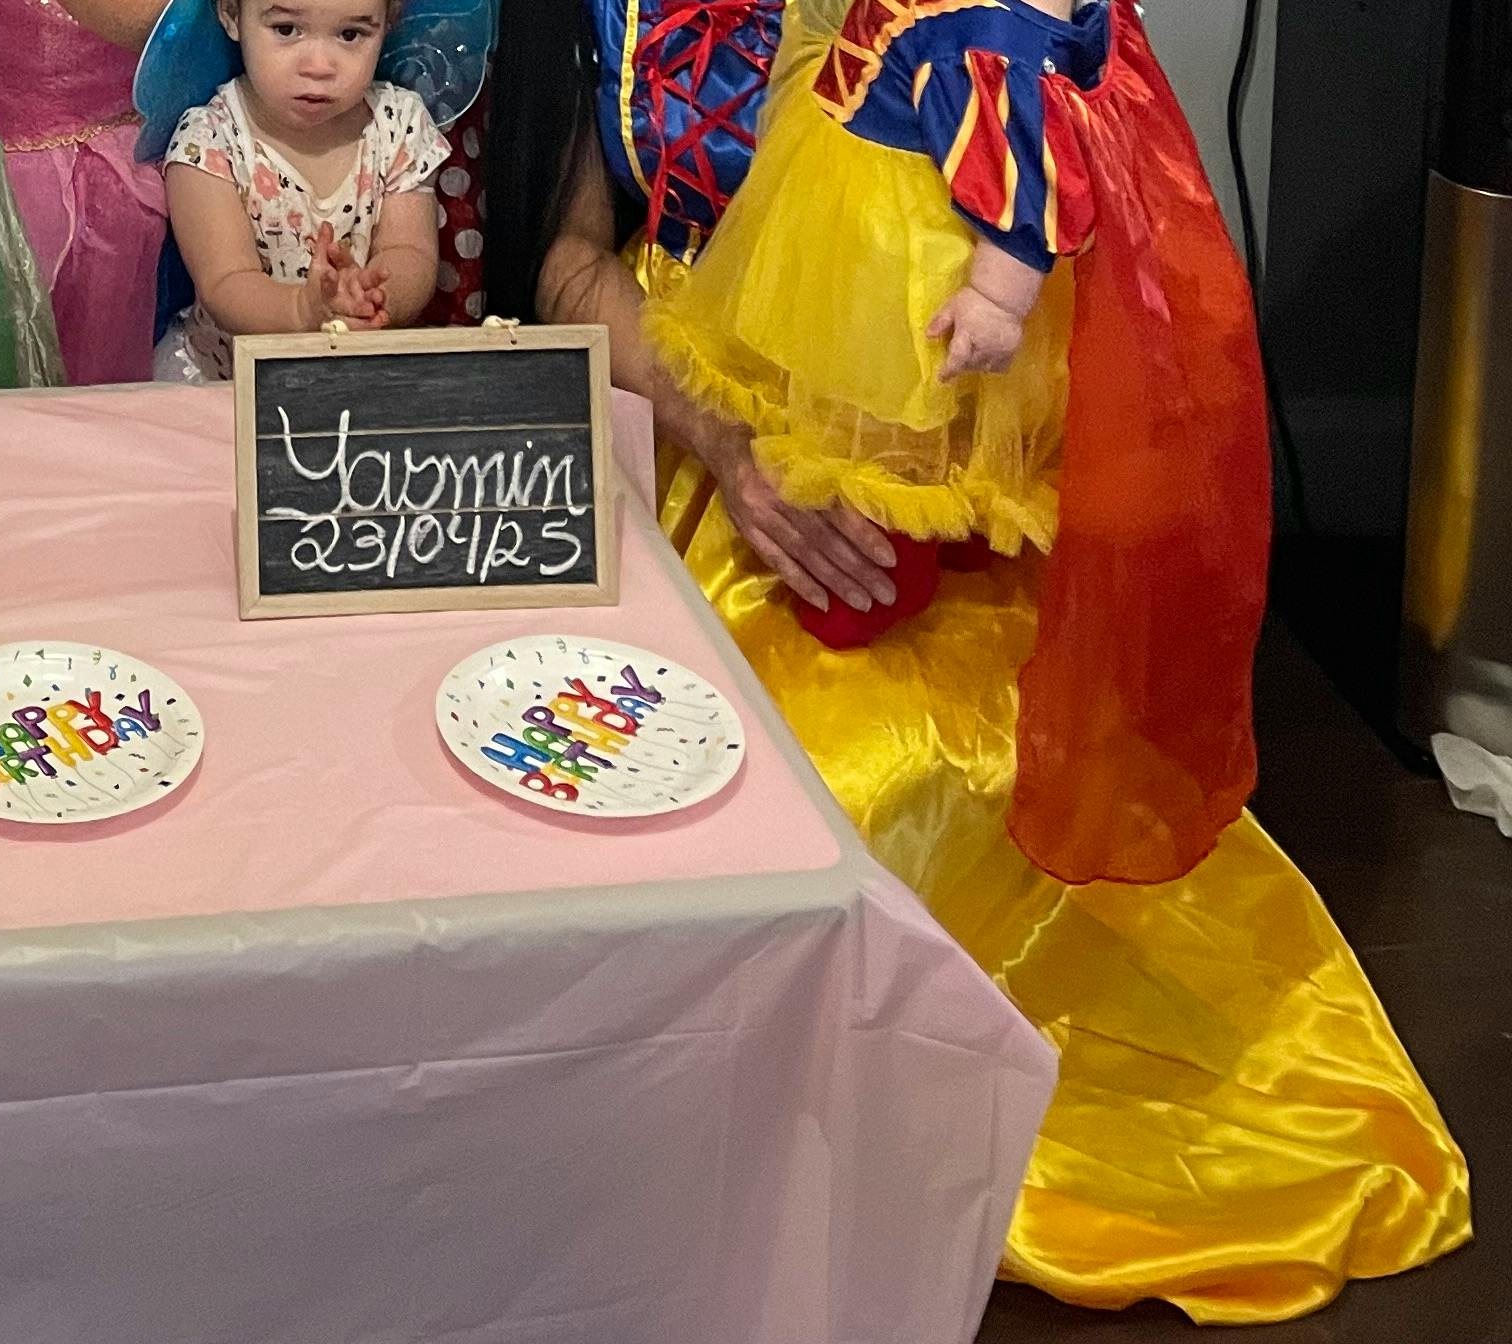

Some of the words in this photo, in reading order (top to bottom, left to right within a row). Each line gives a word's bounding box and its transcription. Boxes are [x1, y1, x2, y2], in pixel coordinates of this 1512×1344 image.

[265, 406, 590, 521] Yasmin
[291, 512, 582, 584] 23/04/25
[480, 677, 619, 773] HAPPY
[519, 664, 663, 802] BIRTHDAY
